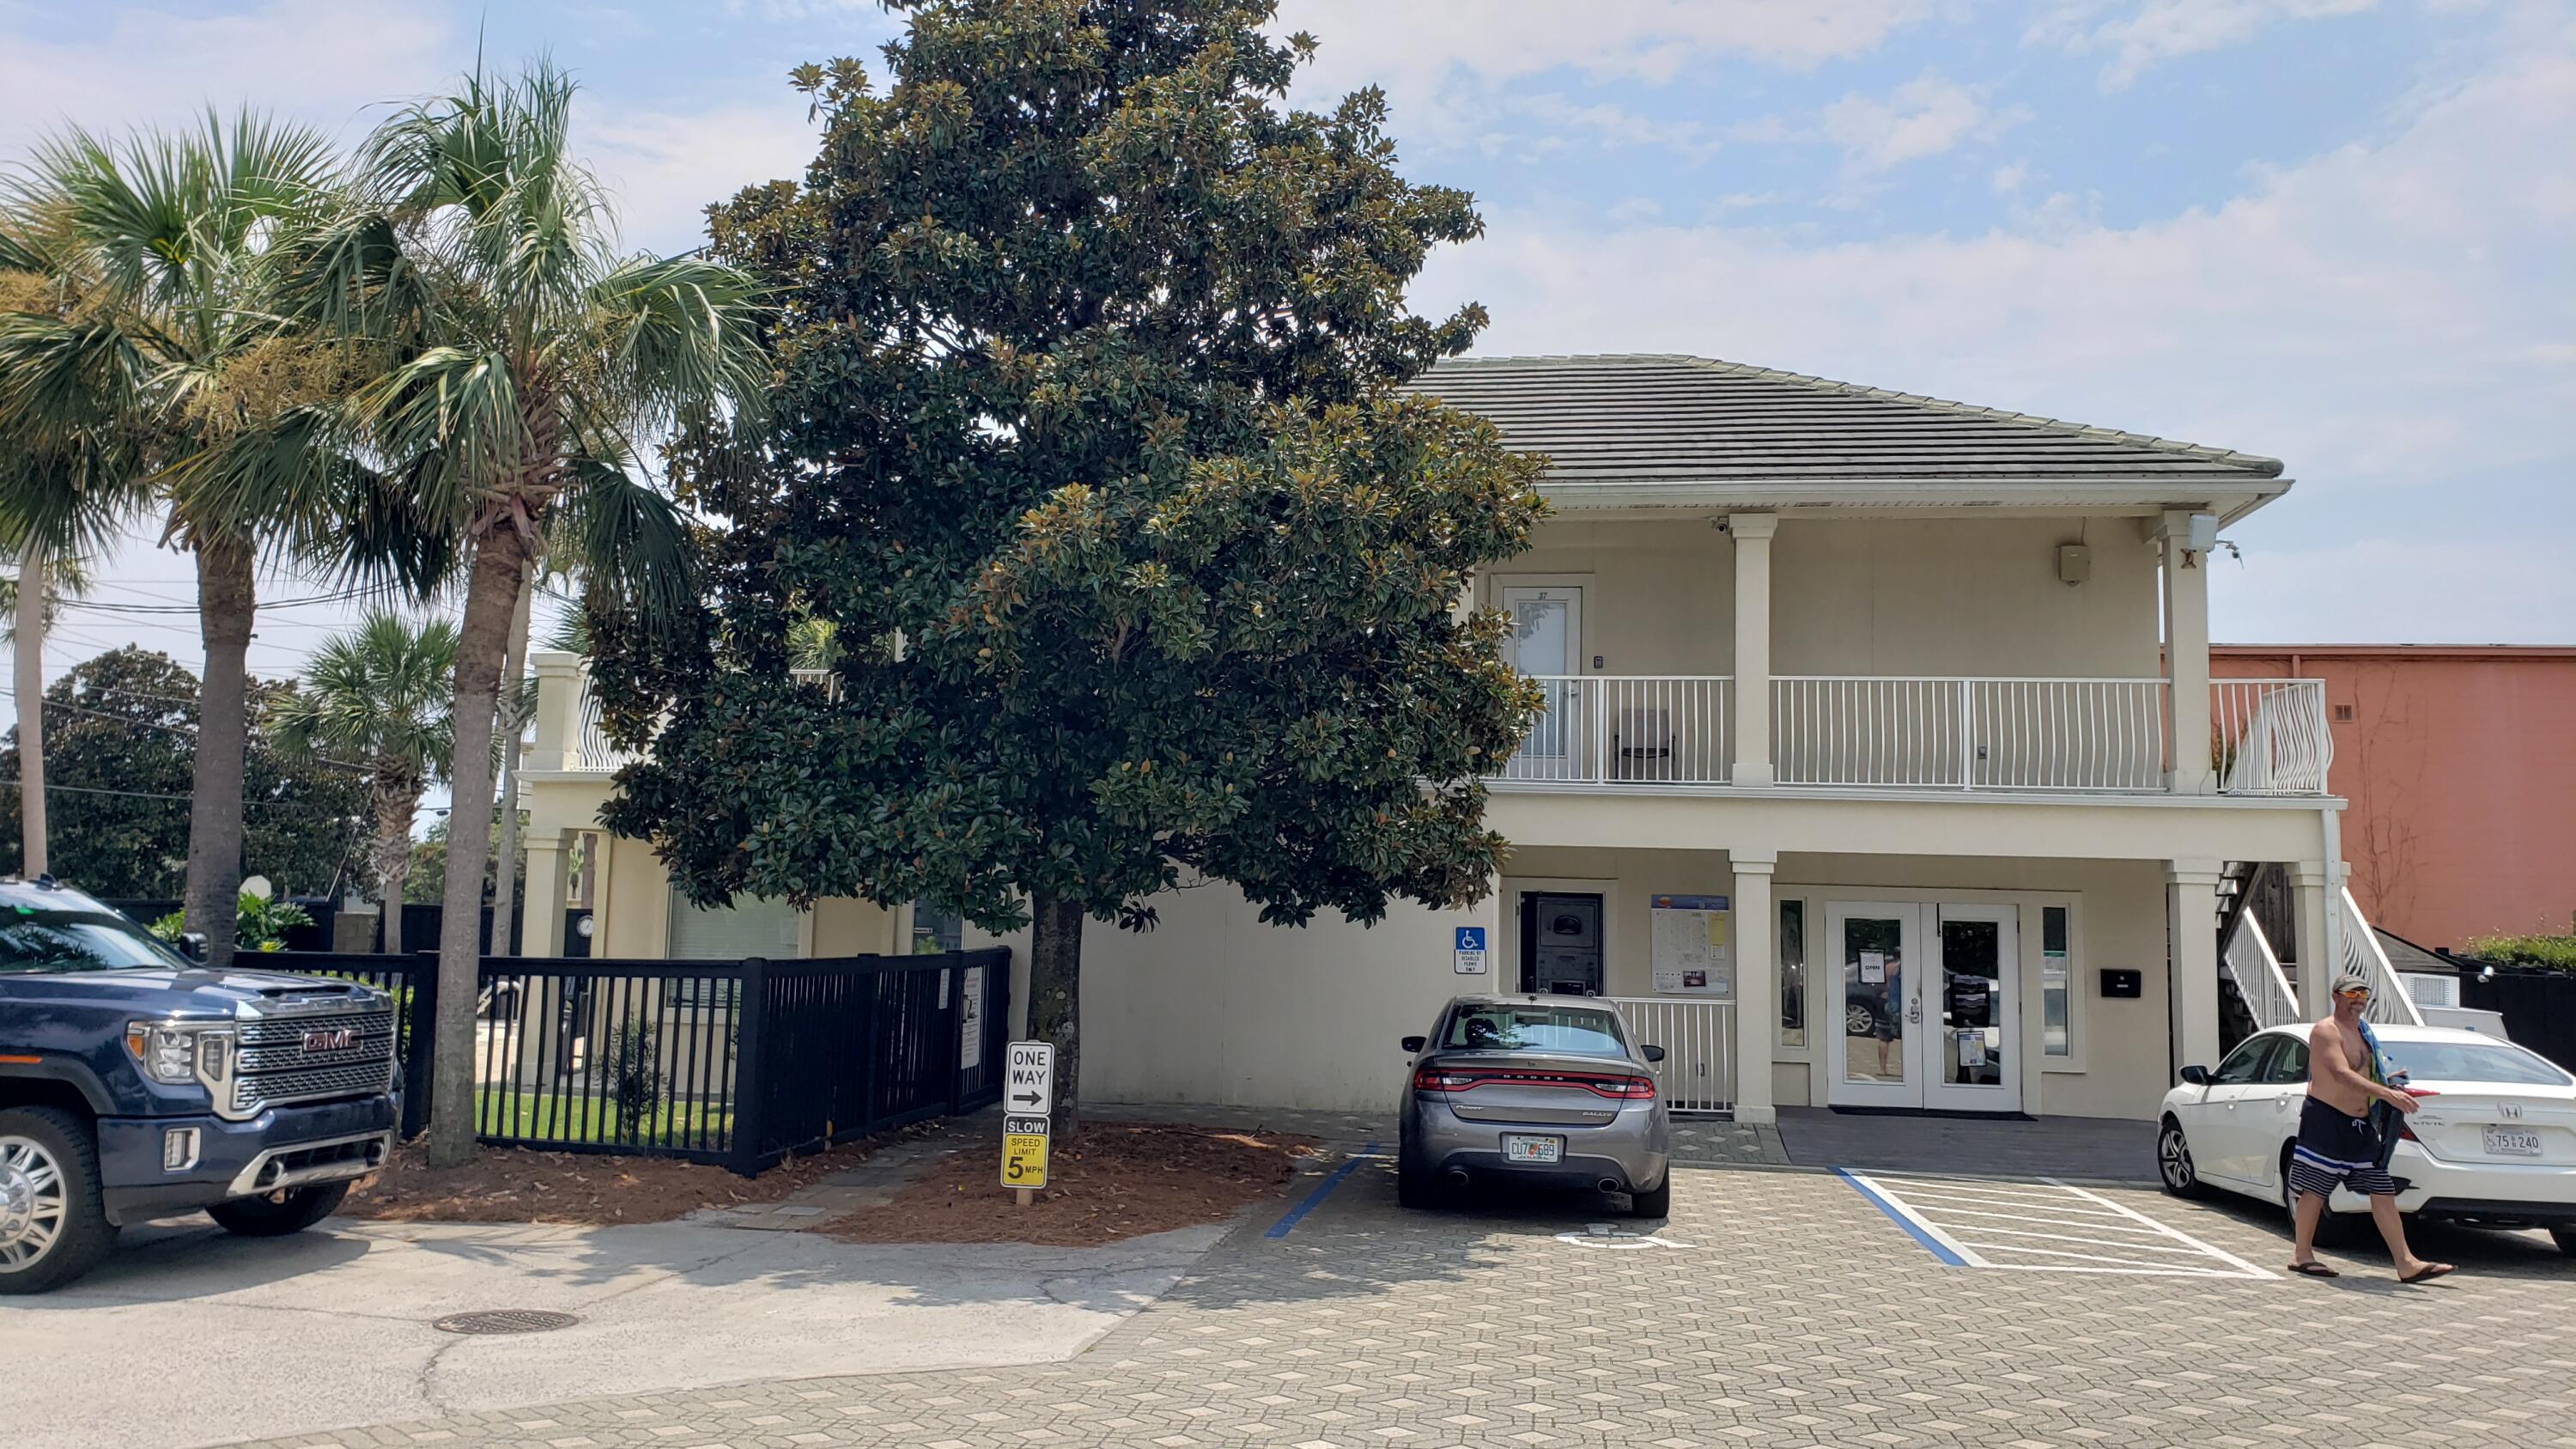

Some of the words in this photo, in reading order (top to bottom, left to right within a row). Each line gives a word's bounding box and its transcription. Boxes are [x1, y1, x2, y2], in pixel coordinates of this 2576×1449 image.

[304, 1029, 358, 1051] GMC
[1014, 1050, 1047, 1066] ONE
[1012, 1070, 1047, 1085] WAY
[1008, 1121, 1046, 1133] SLOW
[1011, 1137, 1041, 1148] SPEED
[1007, 1156, 1024, 1179] 5
[1024, 1166, 1043, 1175] MPH
